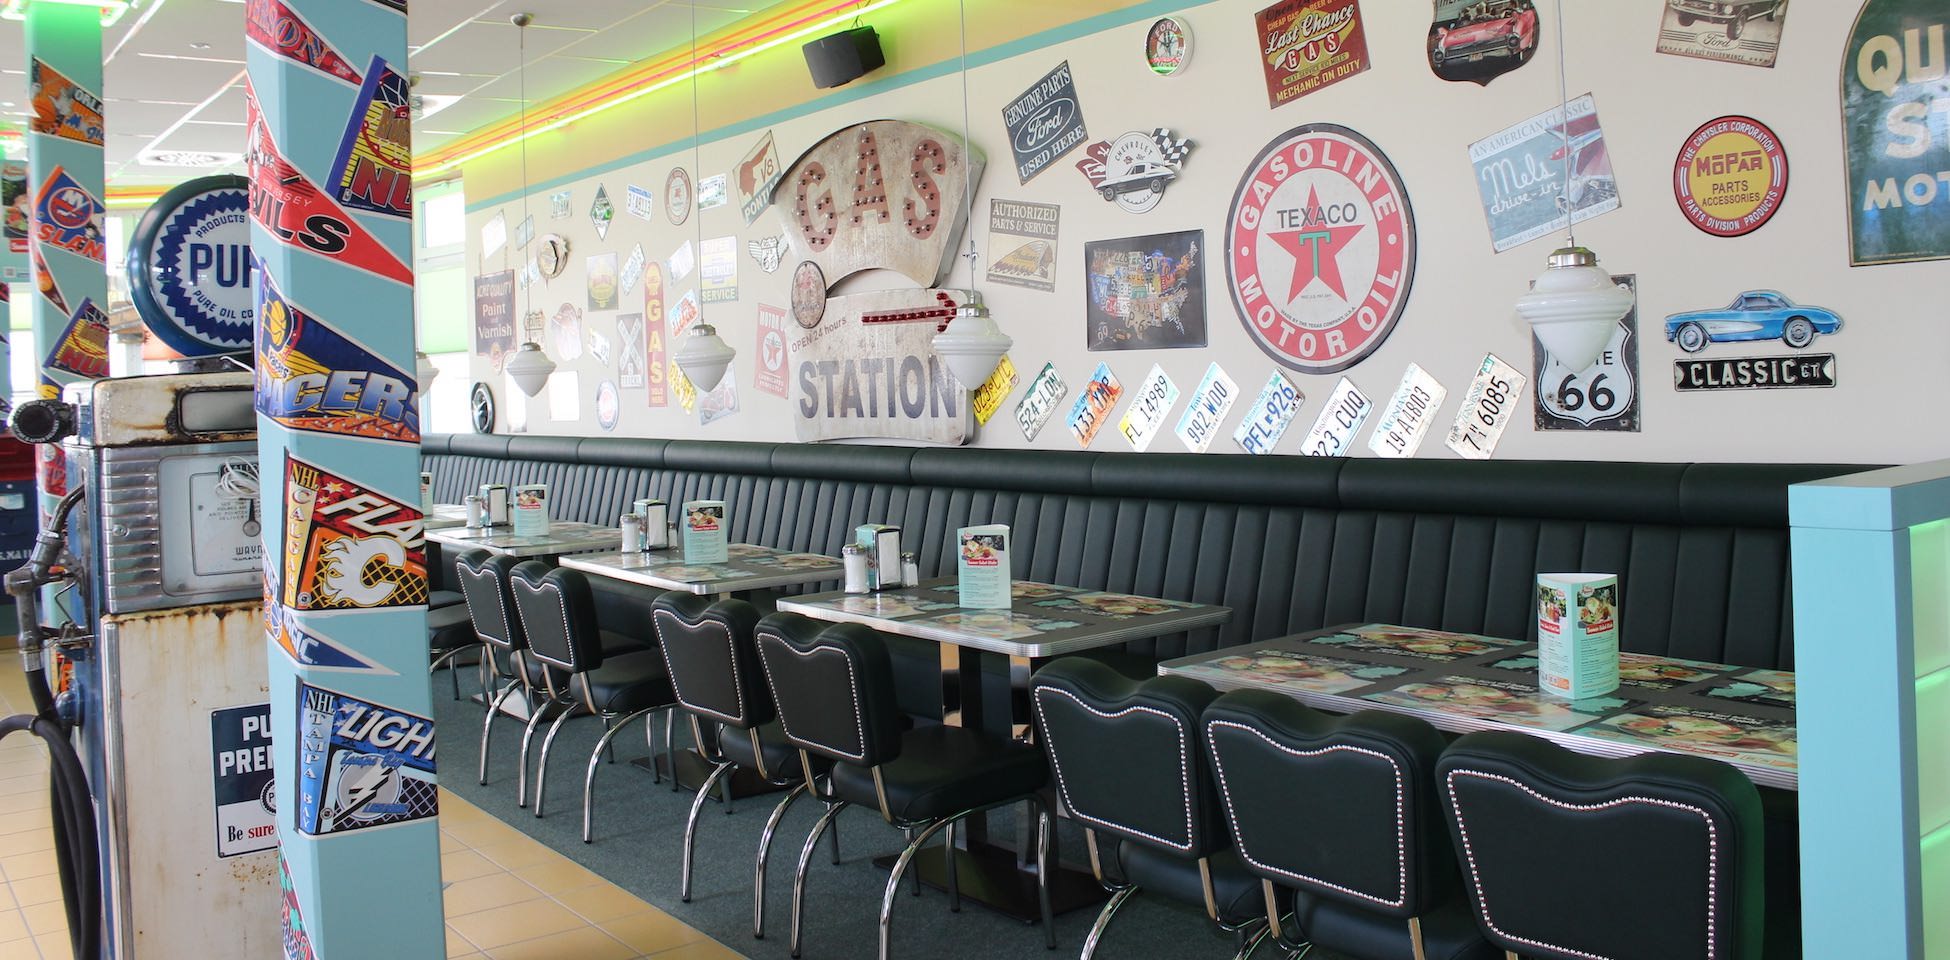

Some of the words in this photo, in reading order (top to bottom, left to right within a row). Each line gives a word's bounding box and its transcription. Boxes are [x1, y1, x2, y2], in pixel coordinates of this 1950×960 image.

[1264, 25, 1301, 55] Last
[1301, 4, 1354, 38] Chance
[1267, 17, 1287, 31] CHEAP
[1703, 33, 1732, 48] Ford
[1288, 31, 1337, 70] GAS
[1004, 87, 1042, 128] GENUINE
[1041, 66, 1071, 100] PARTS
[1276, 76, 1321, 102] MECHANIC
[1322, 70, 1336, 83] ON
[1337, 59, 1360, 77] DUTY
[1027, 105, 1063, 147] Ford
[1474, 147, 1489, 159] AN
[1488, 119, 1544, 152] AMERICAN
[1545, 99, 1591, 128] CLASSIC
[1682, 146, 1696, 163] THE
[1693, 122, 1728, 147] CHRYSLER
[1730, 121, 1775, 153] CORPORATION
[1020, 149, 1051, 178] USED
[1051, 125, 1084, 157] HERE
[1114, 141, 1153, 161] CHEVROLET
[796, 131, 946, 253] GAS
[1240, 140, 1398, 230] GASOLINE
[1482, 153, 1557, 198] Mels
[1712, 180, 1749, 195] PARTS
[992, 202, 1058, 222] AUTHORIZED
[1277, 203, 1357, 230] TEXACO
[1491, 181, 1561, 215] drive-in
[1685, 199, 1706, 222] PARTS
[1706, 217, 1740, 231] DIVISION
[1743, 190, 1778, 227] PRODUCTS
[1702, 192, 1761, 207] ACCESSORIES
[195, 214, 245, 238] PRODUCTS
[992, 218, 1015, 231] PARTS
[1015, 220, 1024, 232] &
[1024, 221, 1057, 235] SERVICE
[193, 290, 217, 312] PURE
[220, 308, 236, 319] OIL
[482, 302, 506, 318] Paint
[702, 286, 737, 301] SERVICE
[478, 325, 513, 339] Varnish
[1238, 274, 1349, 359] MOTOR
[1356, 270, 1400, 332] OIL
[647, 299, 664, 385] GAS
[792, 334, 813, 353] OPEN
[813, 329, 824, 341] 24
[824, 318, 848, 336] hours
[799, 355, 957, 419] STATION
[1690, 359, 1798, 387] CLASSIC
[1125, 423, 1143, 445] FL
[1140, 375, 1168, 422] 14989
[1266, 383, 1295, 420] 926
[1335, 390, 1366, 430] CUQ
[1382, 387, 1411, 431] MONTANA
[1477, 375, 1510, 427] 6085
[1557, 373, 1616, 412] 66
[1073, 406, 1096, 440] 133
[1187, 411, 1211, 444] 992
[1313, 398, 1342, 436] Washington
[291, 463, 320, 491] NHL
[304, 689, 336, 715] NHL
[228, 825, 244, 843] Be
[248, 824, 275, 840] sure
